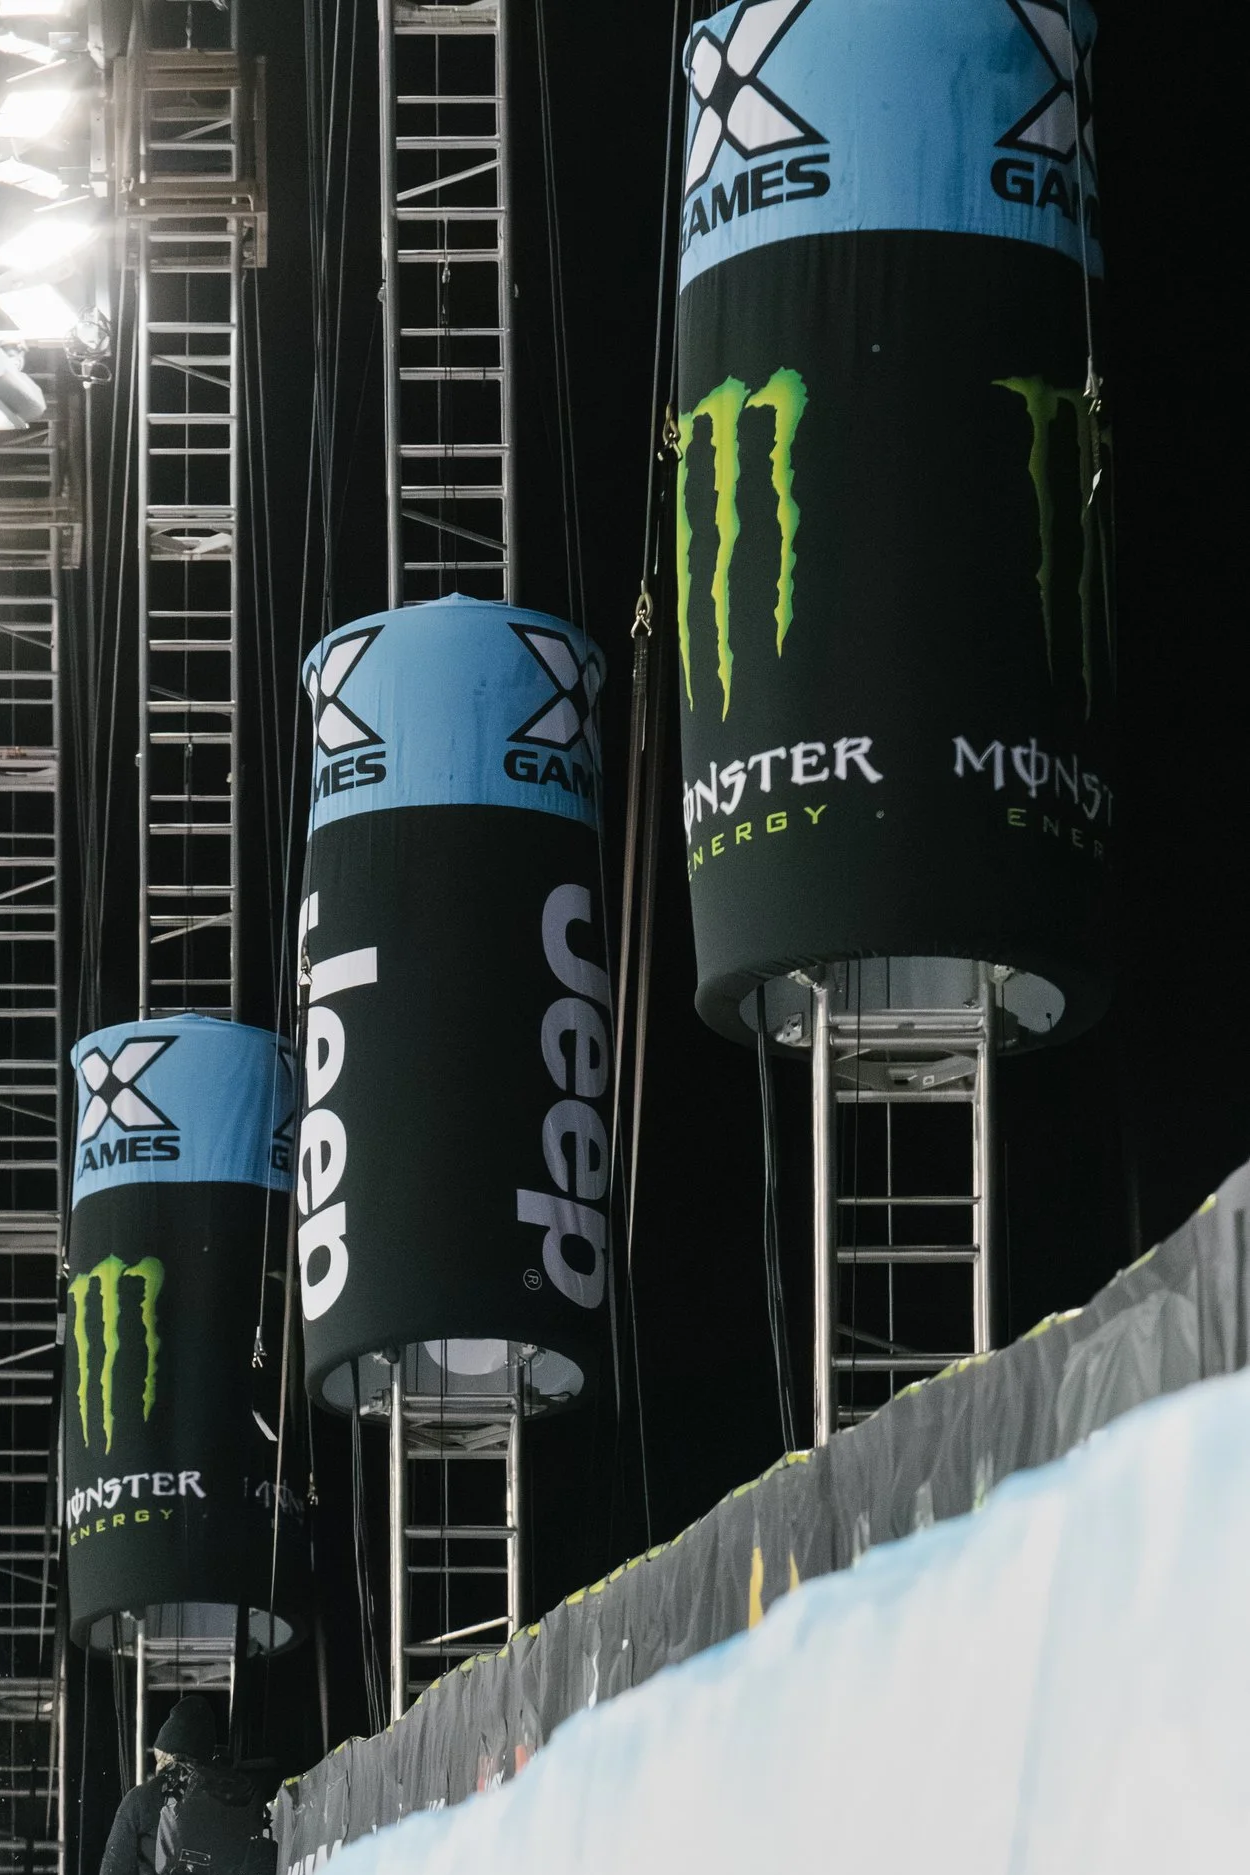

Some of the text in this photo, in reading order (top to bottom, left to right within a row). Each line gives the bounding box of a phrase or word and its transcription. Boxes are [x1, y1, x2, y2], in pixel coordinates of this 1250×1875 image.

[682, 153, 830, 252] AMES
[516, 883, 610, 1309] Jeep
[78, 1135, 181, 1181] AMES
[69, 1508, 174, 1547] ENERGY
